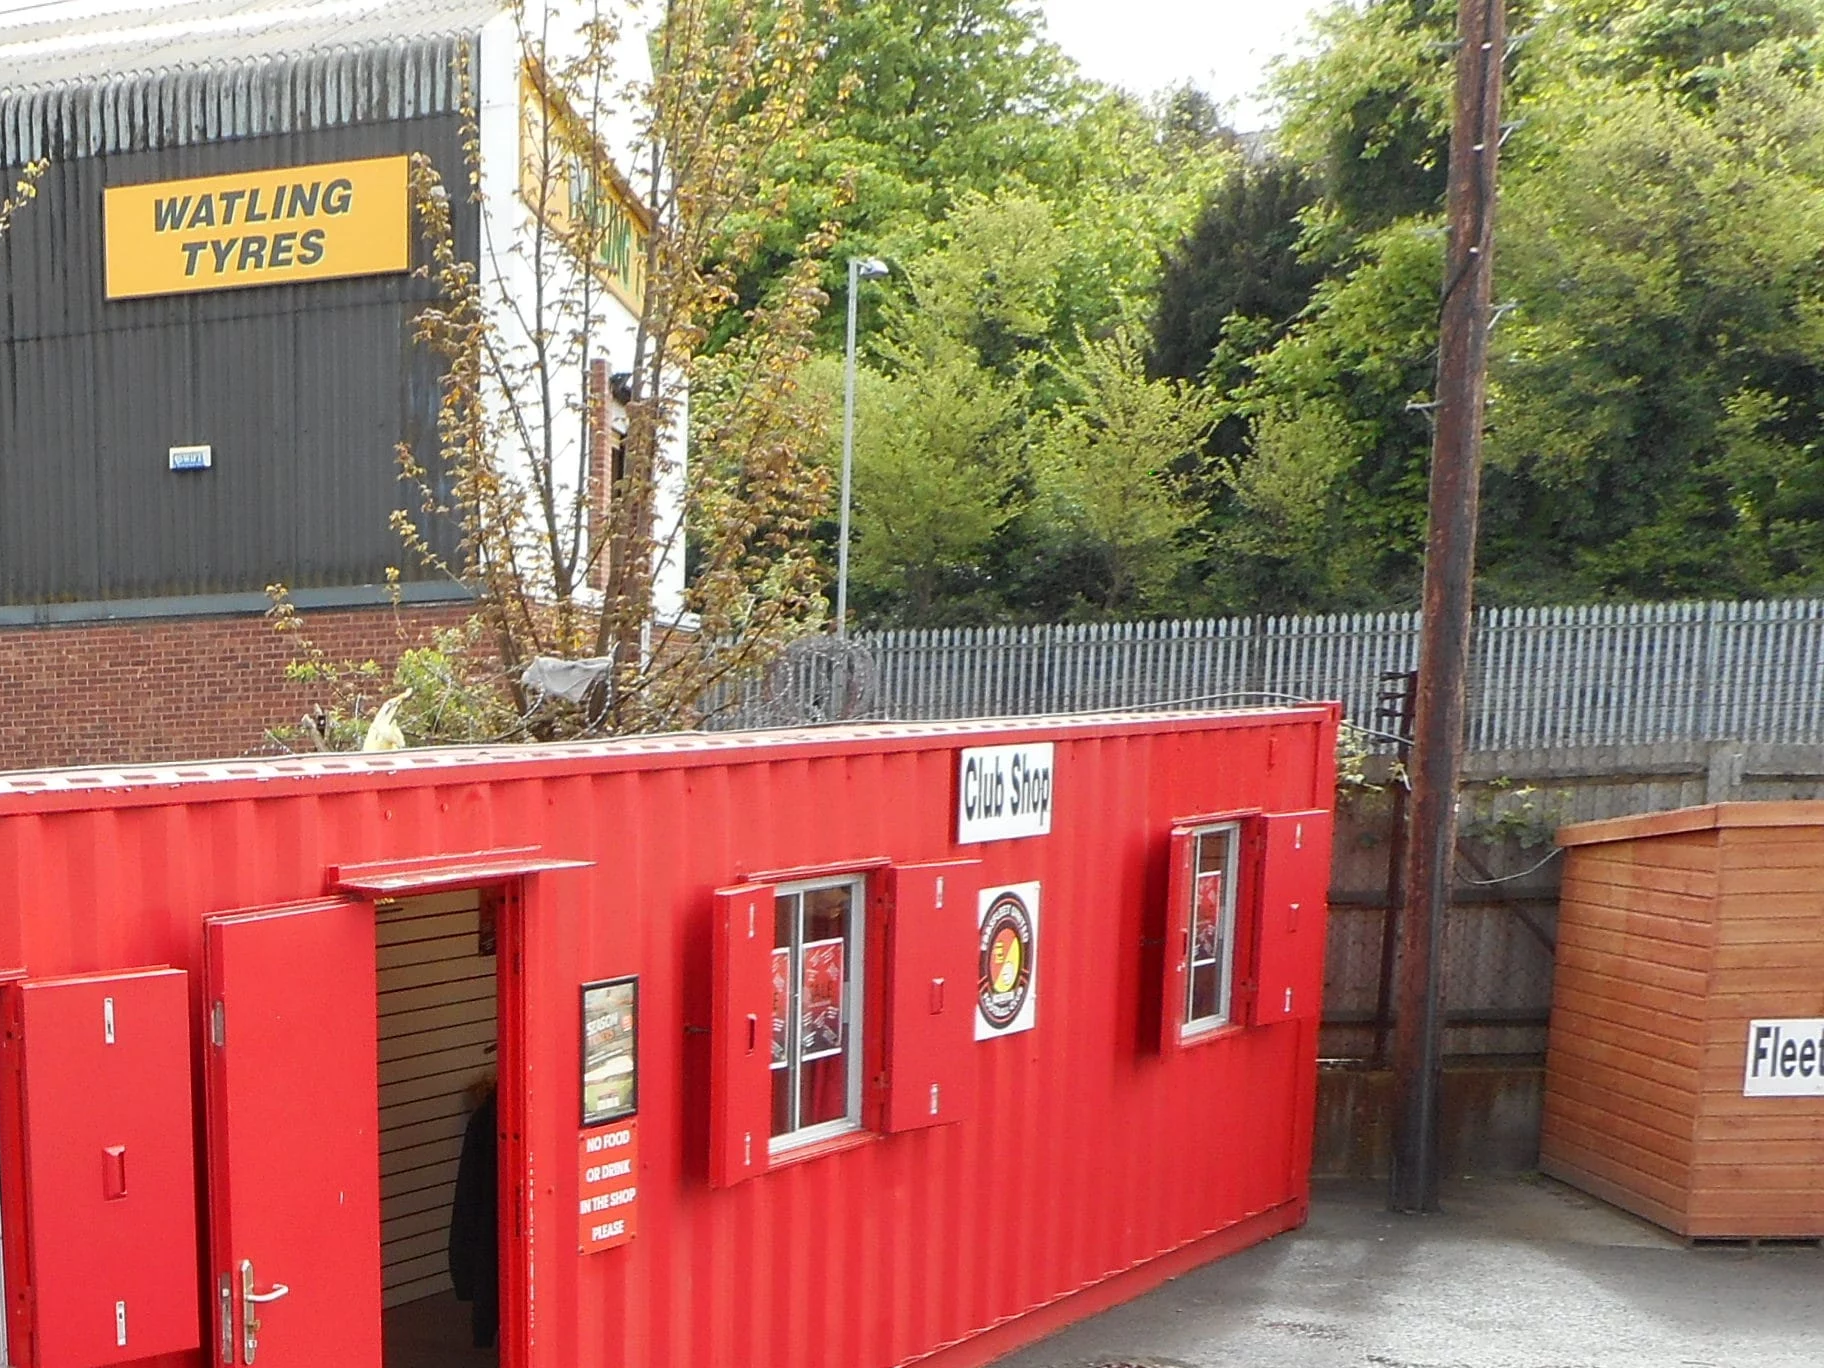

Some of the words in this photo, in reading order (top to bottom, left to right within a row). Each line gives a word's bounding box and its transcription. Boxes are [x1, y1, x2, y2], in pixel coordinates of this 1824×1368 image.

[154, 178, 353, 232] WATLING
[181, 229, 326, 276] TYRES
[964, 756, 1004, 821] Club
[1010, 752, 1050, 826] Shop
[586, 1011, 618, 1036] SEASON
[586, 1136, 602, 1153] NO
[603, 1130, 630, 1149] FOOD
[586, 1166, 601, 1183] OR
[601, 1159, 631, 1179] DRINK
[580, 1200, 591, 1215] IN
[592, 1194, 610, 1212] THE
[610, 1187, 636, 1207] SHOP
[591, 1220, 625, 1242] PLEASE
